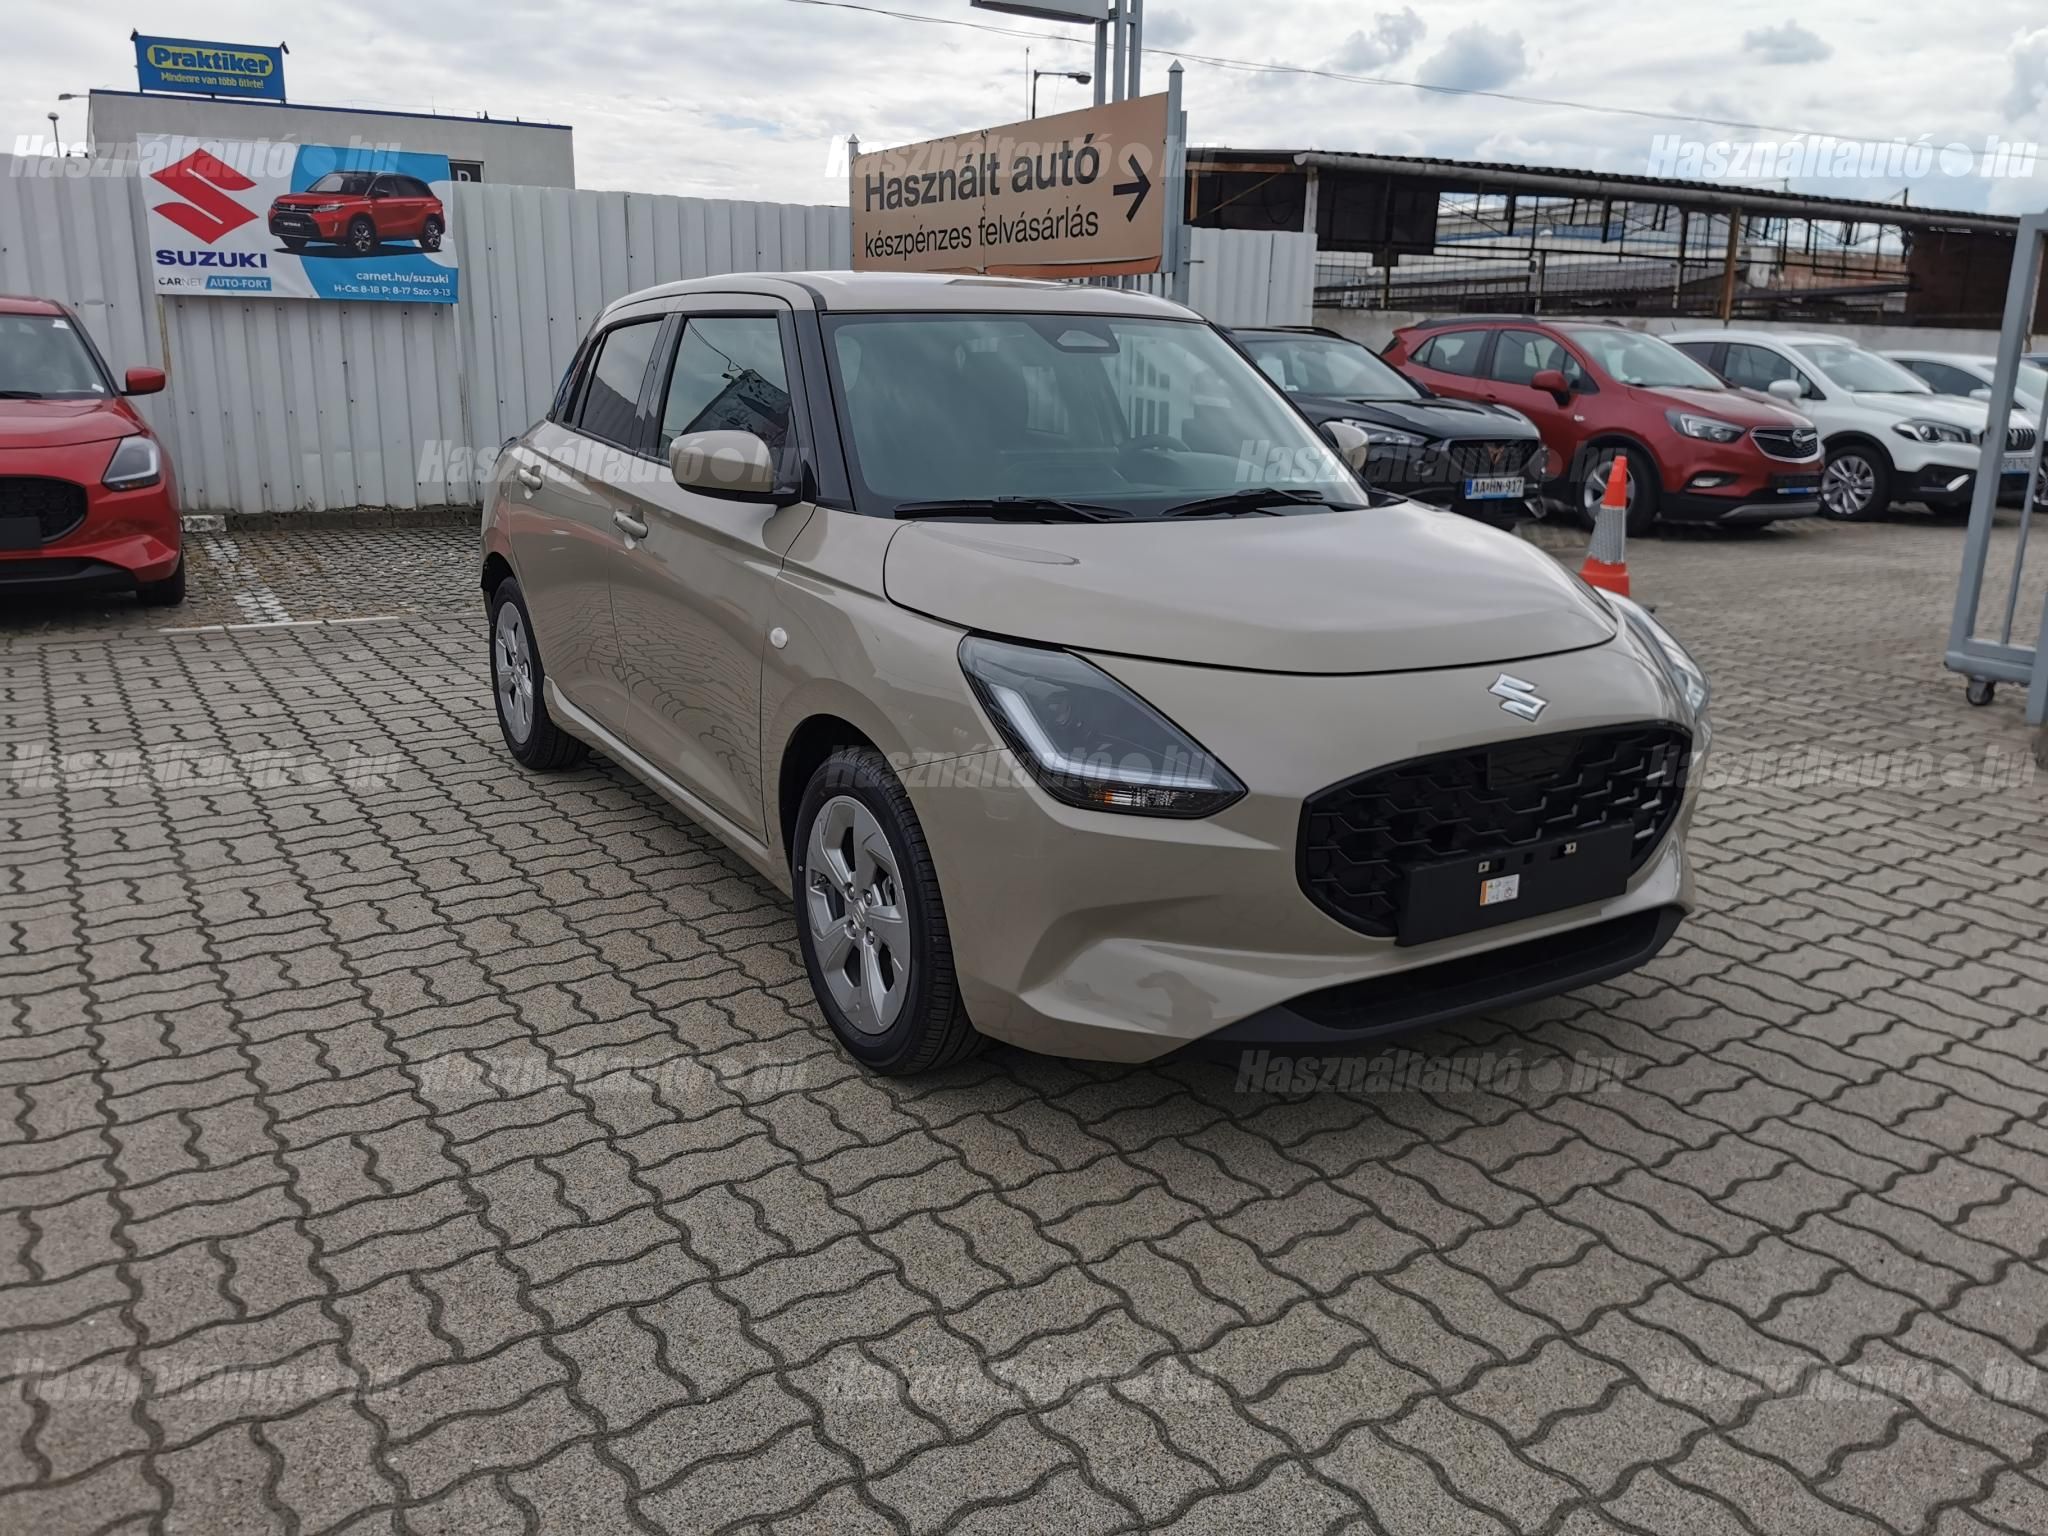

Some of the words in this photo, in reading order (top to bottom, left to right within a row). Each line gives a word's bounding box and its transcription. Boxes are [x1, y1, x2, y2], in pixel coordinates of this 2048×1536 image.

[153, 47, 270, 74] Praktiker
[161, 72, 200, 84] Mindenre
[201, 77, 217, 86] van
[218, 76, 237, 87] több
[865, 152, 1001, 212] Használt
[1011, 133, 1100, 193] autó
[865, 224, 972, 261] készpénzes
[978, 204, 1099, 247] felvásárlás
[155, 249, 267, 269] SUZUKI
[209, 278, 268, 289] AUTO-FORT
[356, 272, 449, 284] carnet.hu/suzuki
[360, 285, 380, 294] 8-18
[382, 286, 391, 294] P:
[392, 286, 411, 295] 8-17
[412, 287, 432, 296] Szo:
[433, 288, 451, 297] 9-13
